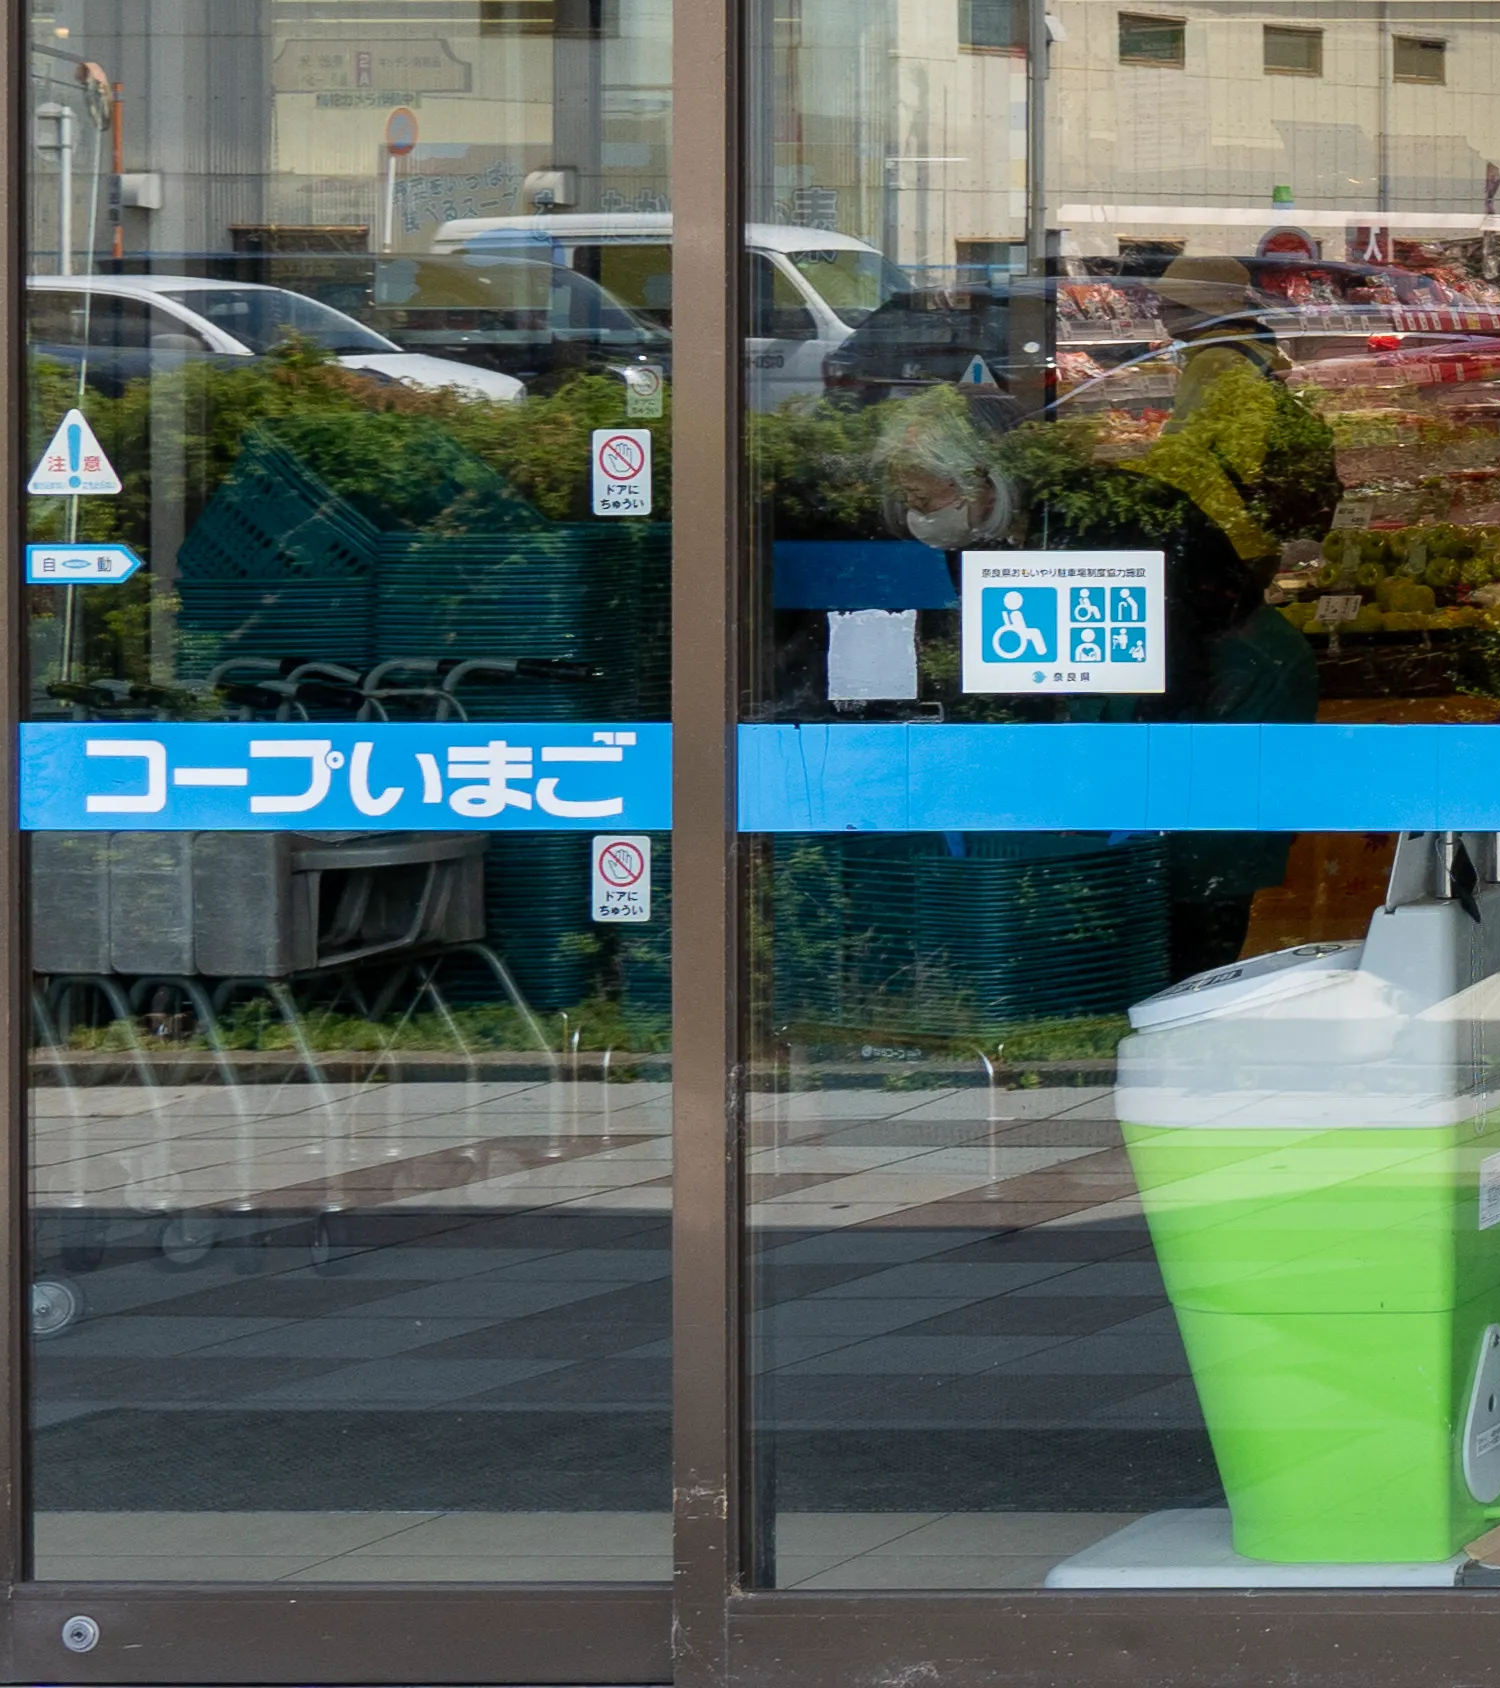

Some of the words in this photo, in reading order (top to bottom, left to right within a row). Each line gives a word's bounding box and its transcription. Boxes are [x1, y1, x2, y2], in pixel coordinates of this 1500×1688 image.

[606, 484, 640, 496] ドアに
[600, 498, 645, 510] ちゅうい
[86, 732, 637, 819] コープいまご
[606, 890, 638, 902] ドアに
[599, 904, 644, 916] ちゅうい
